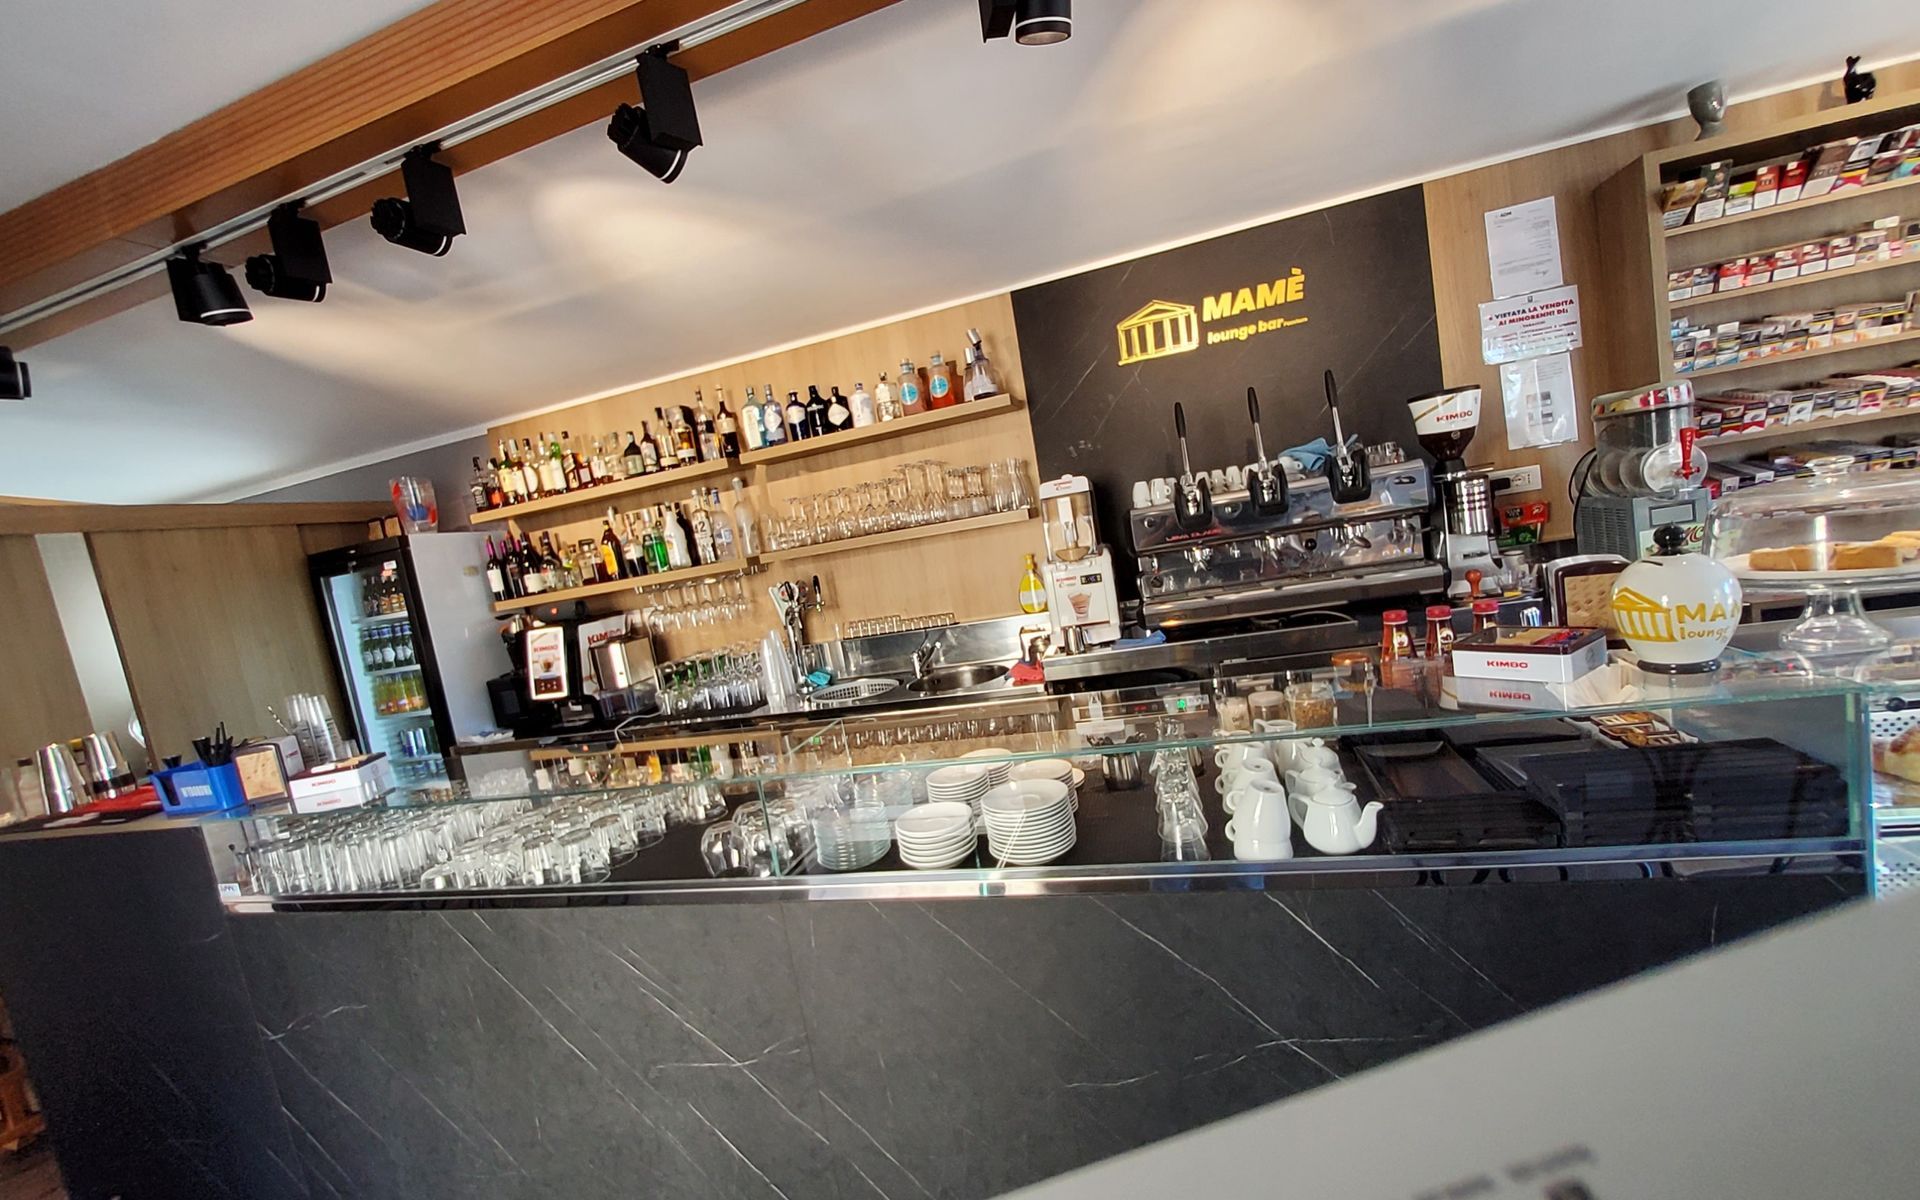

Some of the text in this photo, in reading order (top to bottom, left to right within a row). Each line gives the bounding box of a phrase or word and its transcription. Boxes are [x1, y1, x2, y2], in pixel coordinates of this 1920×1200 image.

[1203, 267, 1305, 322] MAMÈ
[1494, 308, 1527, 320] VIETATA
[1527, 305, 1538, 314] LA
[1539, 298, 1575, 311] VENDITA
[1508, 310, 1555, 324] MINORENNI
[1207, 324, 1257, 345] lounge
[1257, 318, 1284, 333] bar
[1436, 410, 1473, 423] KIMBO
[1486, 660, 1529, 669] KIMBO
